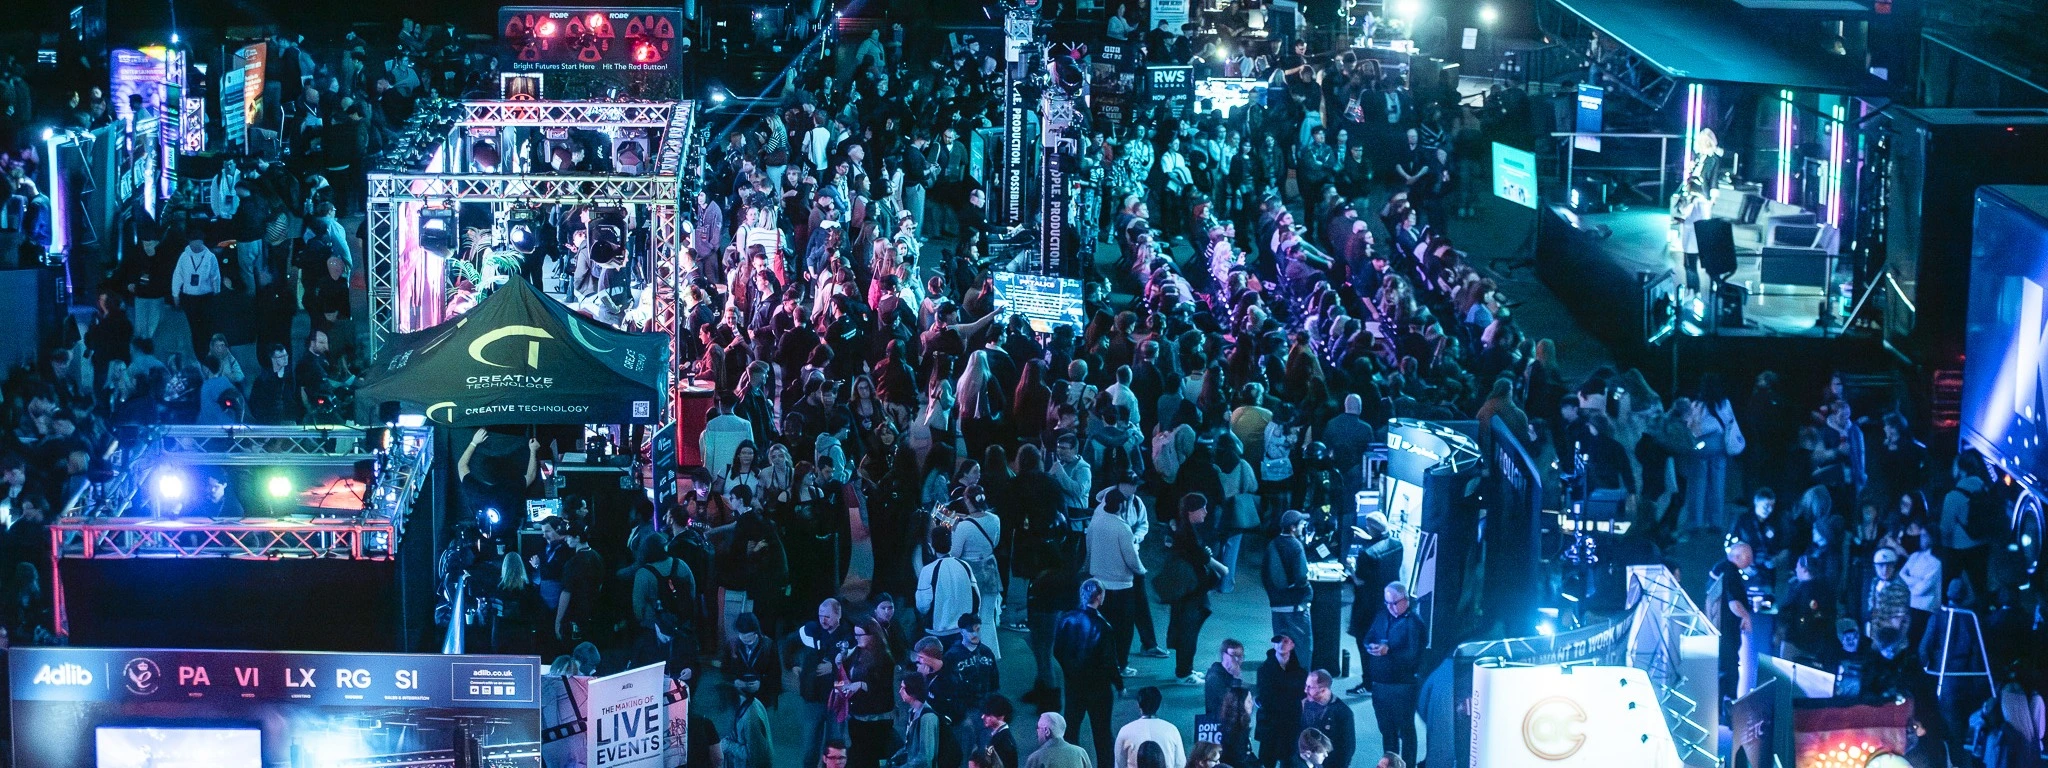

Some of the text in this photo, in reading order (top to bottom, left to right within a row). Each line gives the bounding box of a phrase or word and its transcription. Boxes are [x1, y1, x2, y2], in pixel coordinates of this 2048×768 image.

[513, 62, 533, 70] Bright
[535, 62, 559, 70] Futures
[1154, 71, 1185, 83] RWS
[1011, 107, 1022, 168] PRODUCTION.
[1009, 169, 1020, 224] POSSIBILITY.
[1050, 201, 1061, 270] PRODUCTION.
[466, 374, 554, 385] CREATIVE
[466, 381, 553, 390] TECHNOLOGY
[465, 404, 515, 415] CREATIVE
[518, 404, 589, 413] TECHNOLOGY
[1573, 640, 1587, 658] TO
[1588, 627, 1615, 653] WORK
[33, 662, 93, 686] Adlib
[178, 666, 211, 686] PA
[234, 667, 259, 687] VI
[285, 668, 316, 688] LX
[336, 669, 371, 689] RG
[395, 669, 418, 689] SI
[473, 669, 513, 677] adlib.co.uk
[602, 695, 654, 715] THE MAKING OF
[596, 703, 660, 747] LIVE
[1470, 690, 1481, 768] chnologies
[596, 735, 660, 766] EVENTS
